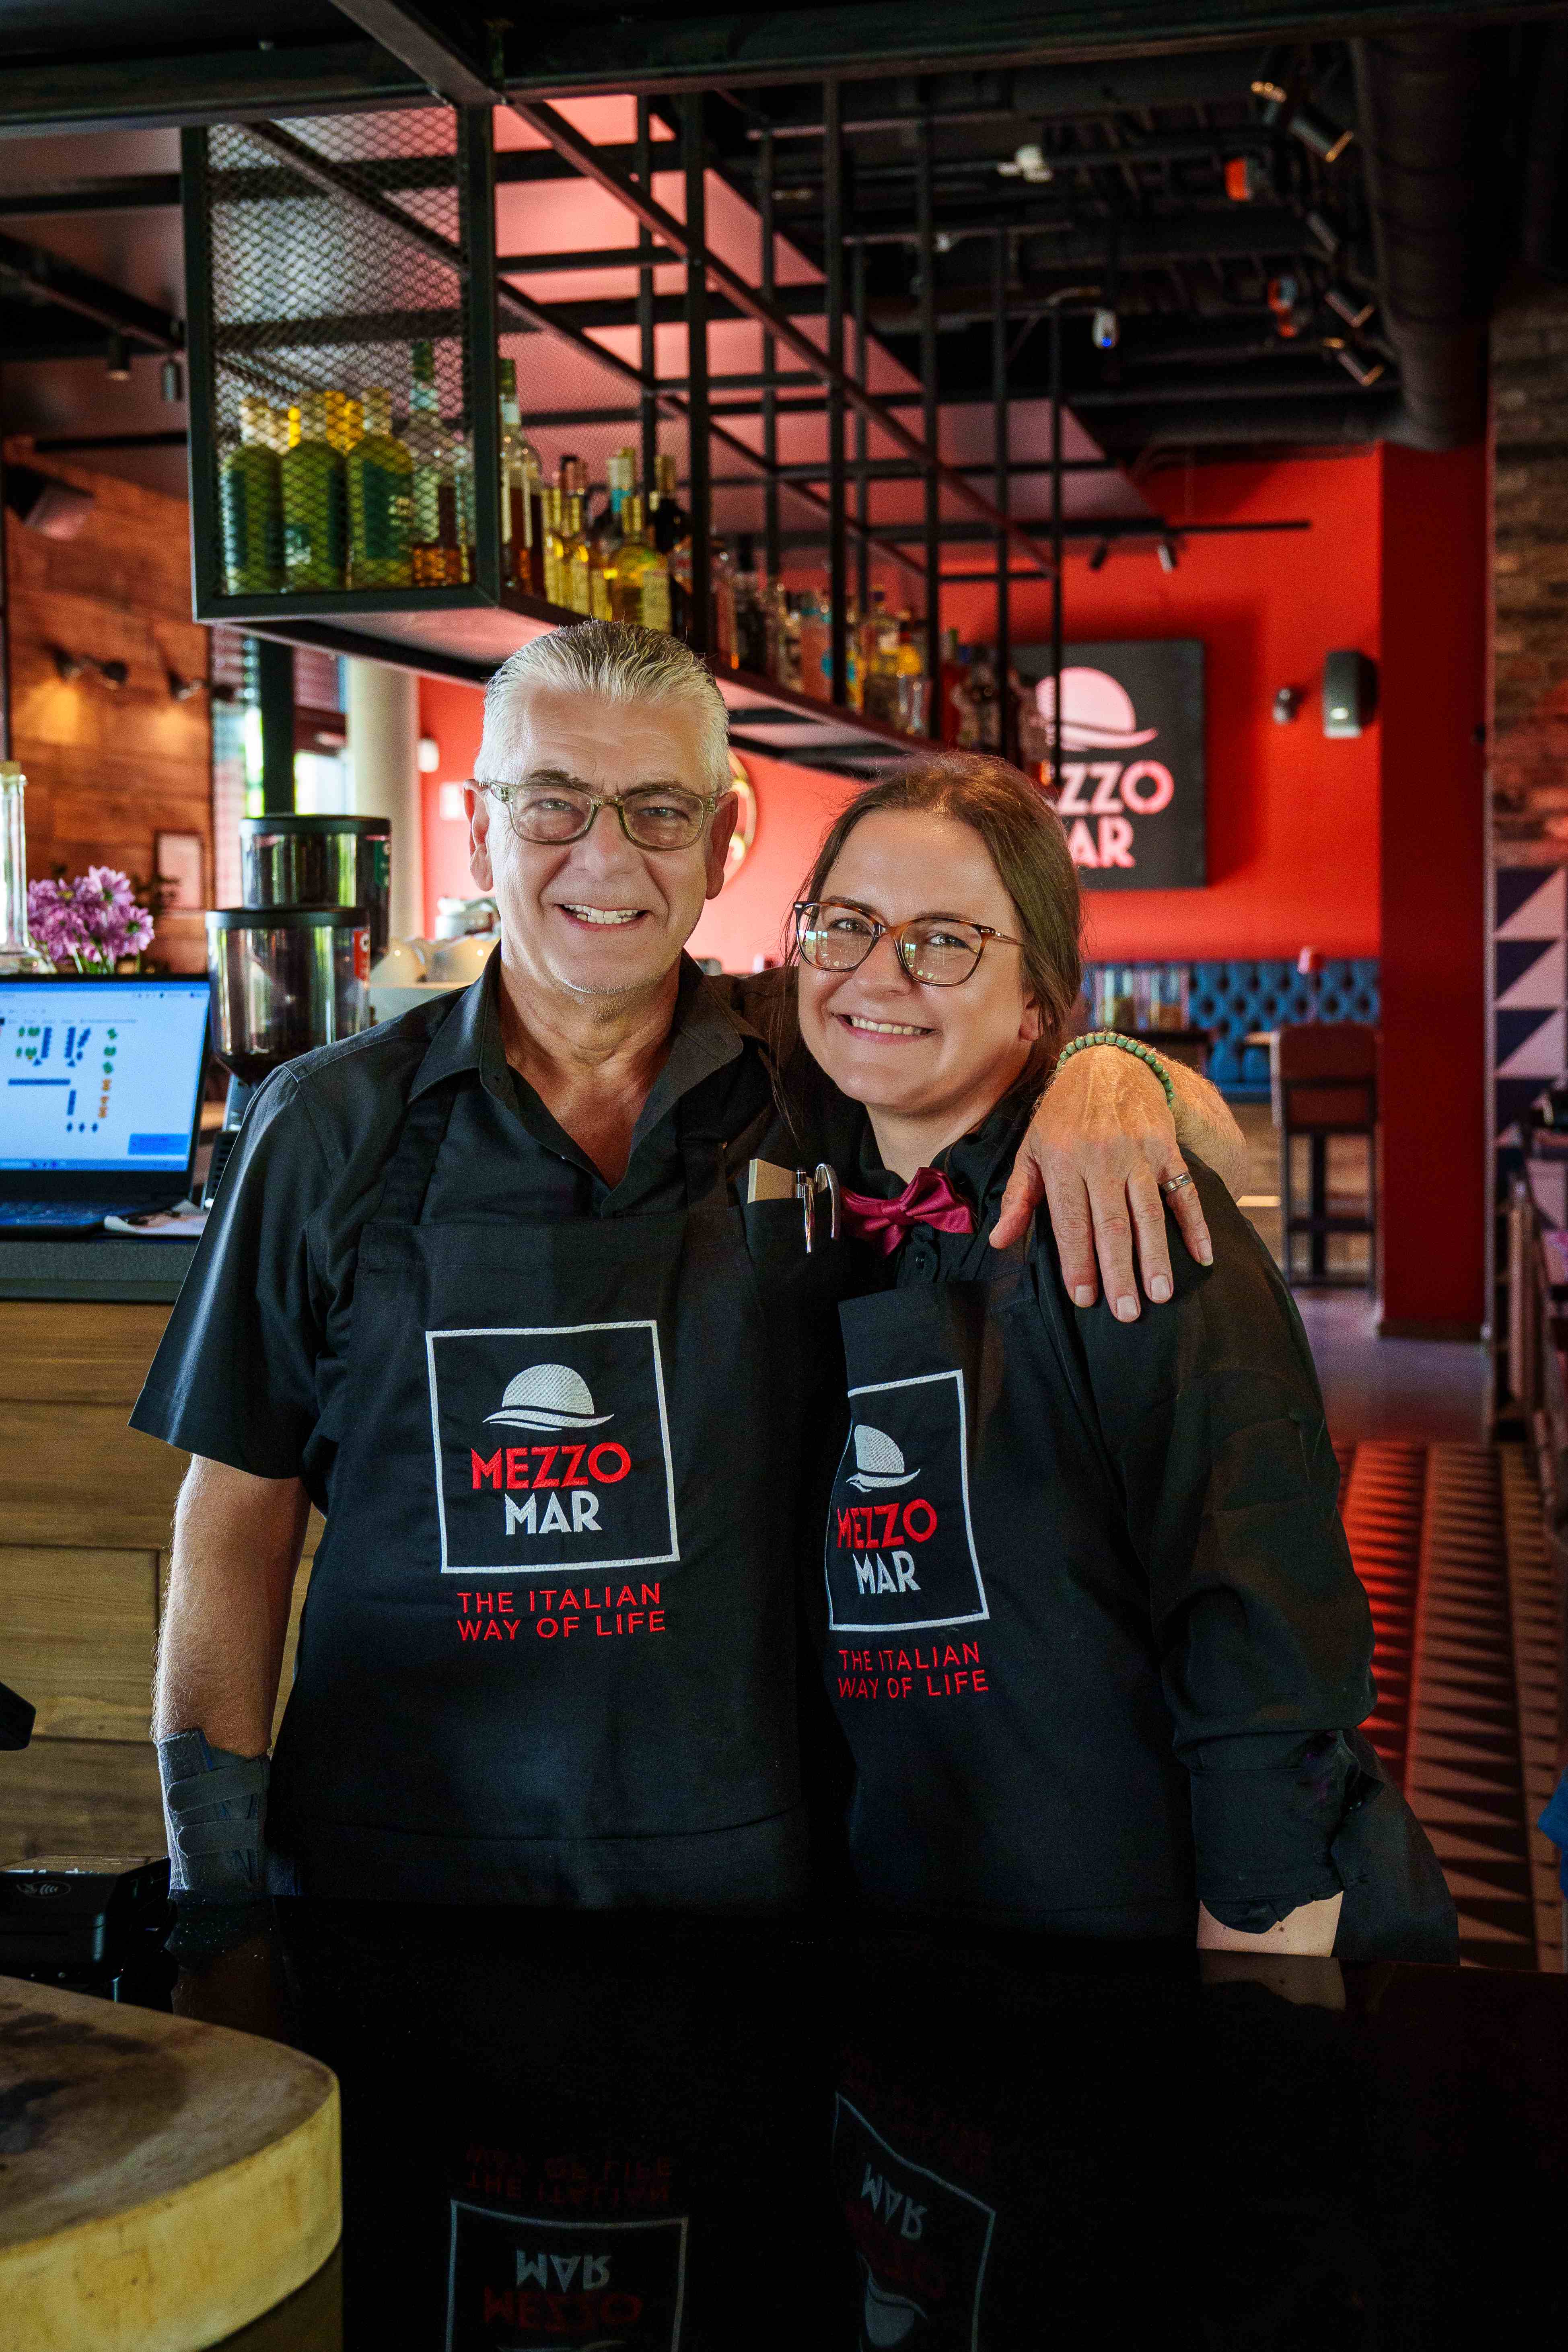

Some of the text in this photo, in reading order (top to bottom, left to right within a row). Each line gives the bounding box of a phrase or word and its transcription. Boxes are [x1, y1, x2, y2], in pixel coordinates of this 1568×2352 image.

[1051, 759, 1175, 815] ZZO
[1068, 816, 1136, 868] AR
[471, 1441, 632, 1490] MEZZO
[504, 1490, 603, 1536] MAR
[836, 1498, 938, 1550] MEZZO
[852, 1550, 922, 1595] MAR
[456, 1582, 662, 1614] THE ITALIAN
[456, 1609, 666, 1642] WAY OF LIFE
[838, 1641, 981, 1672] THE ITALIAN
[837, 1669, 990, 1700] WAY OF LIFE
